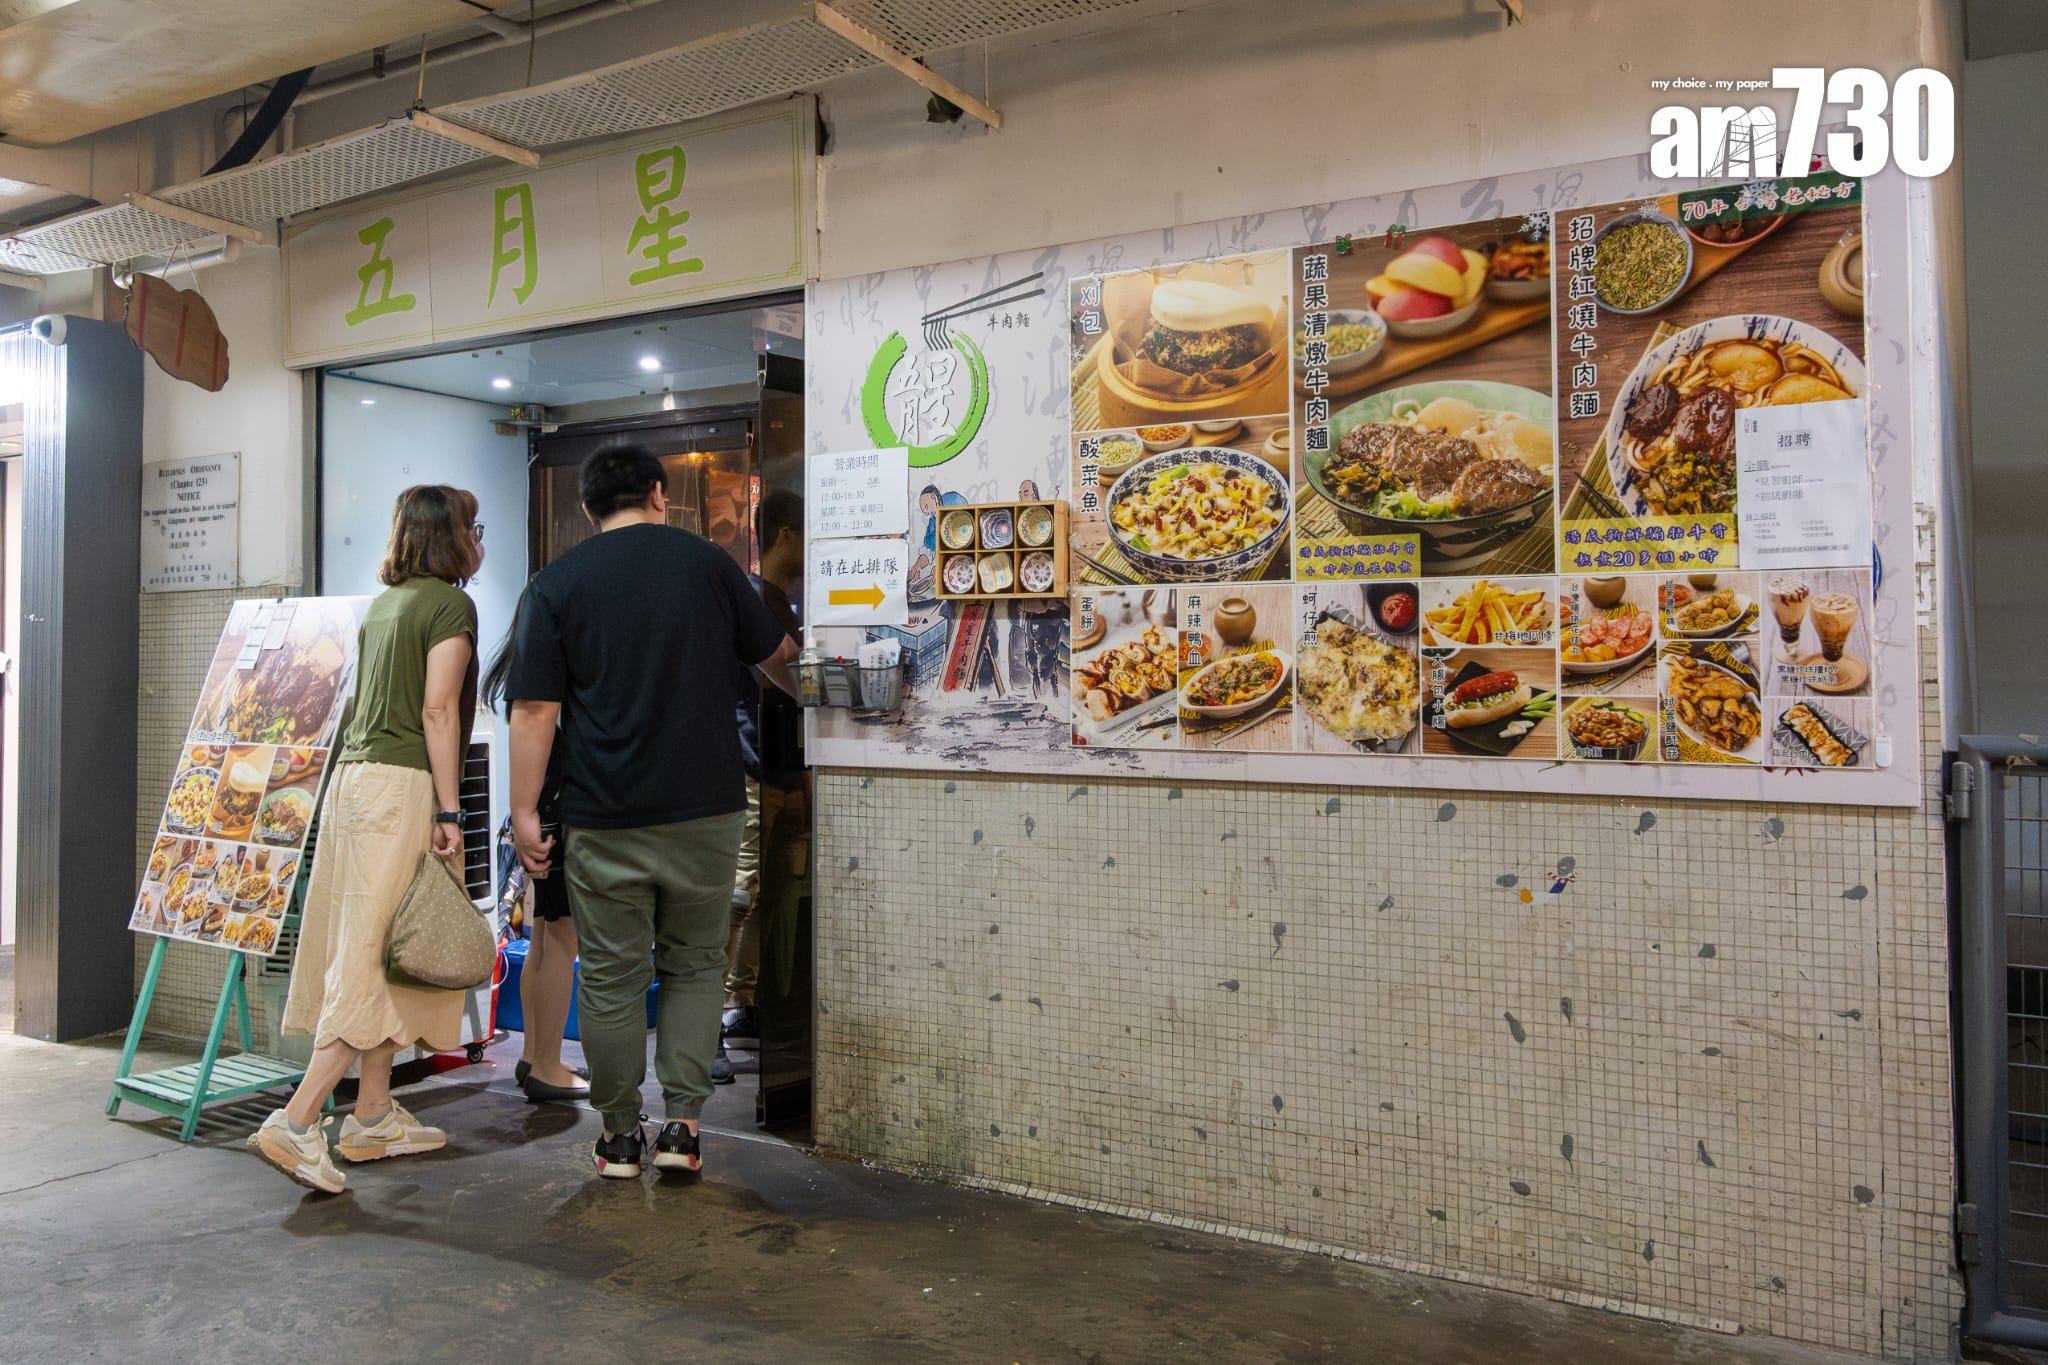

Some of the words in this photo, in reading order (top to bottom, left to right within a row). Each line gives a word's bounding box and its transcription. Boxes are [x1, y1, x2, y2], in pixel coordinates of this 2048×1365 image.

[344, 145, 704, 328] 五月星
[1081, 287, 1101, 334] 刈包
[1569, 215, 1599, 418] 招牌紅燒牛肉麵
[1303, 255, 1329, 451] 蔬果清燉牛肉麵
[835, 455, 879, 471] 營業時間
[1778, 433, 1812, 448] 招聘
[177, 491, 201, 502] NOTICE
[1080, 438, 1100, 513] 酸菜魚
[819, 557, 899, 577] 請在此排隊
[1081, 596, 1094, 629] 蛋餅
[1187, 594, 1202, 665] 麻辣鴨血
[1303, 592, 1319, 646] 蚵仔煎
